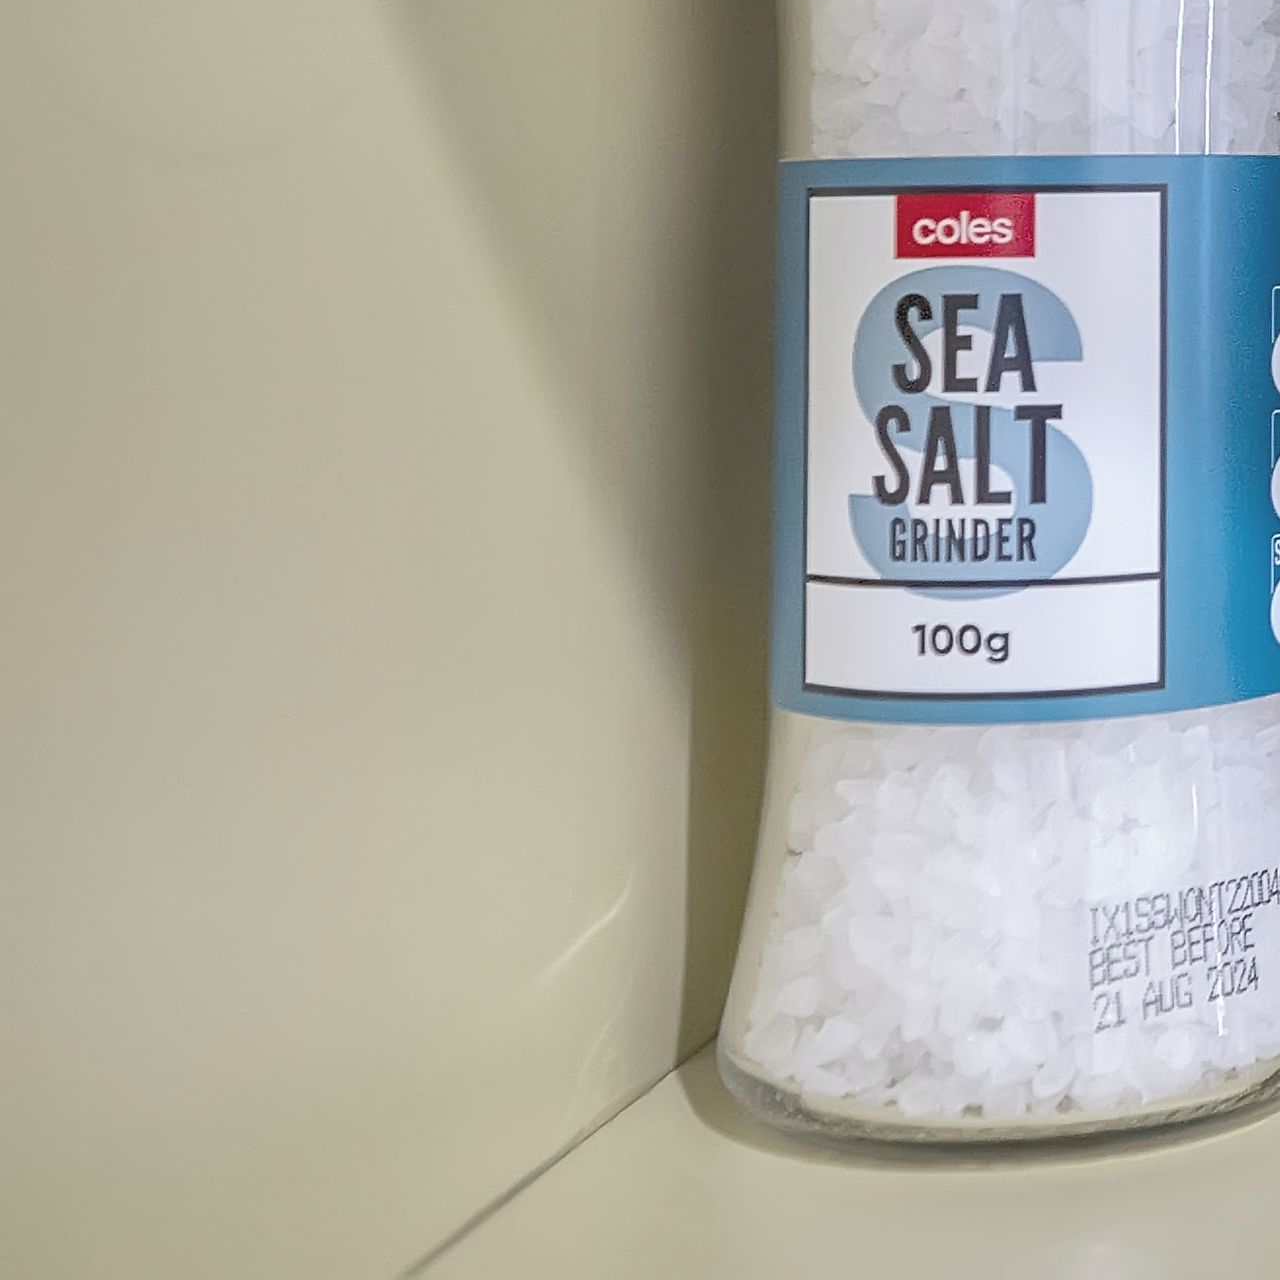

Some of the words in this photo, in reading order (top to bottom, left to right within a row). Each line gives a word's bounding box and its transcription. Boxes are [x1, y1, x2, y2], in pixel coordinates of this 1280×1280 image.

[912, 210, 1013, 244] coles
[892, 292, 1038, 394] SEA
[873, 403, 1063, 506] SALT
[888, 517, 1038, 563] GRINDER
[911, 624, 1010, 663] 100g
[1088, 936, 1154, 990] BEST
[1170, 913, 1255, 970] BEFORE
[1093, 991, 1126, 1034] 21
[1142, 973, 1193, 1021] AUG
[1207, 956, 1259, 1003] 2024
